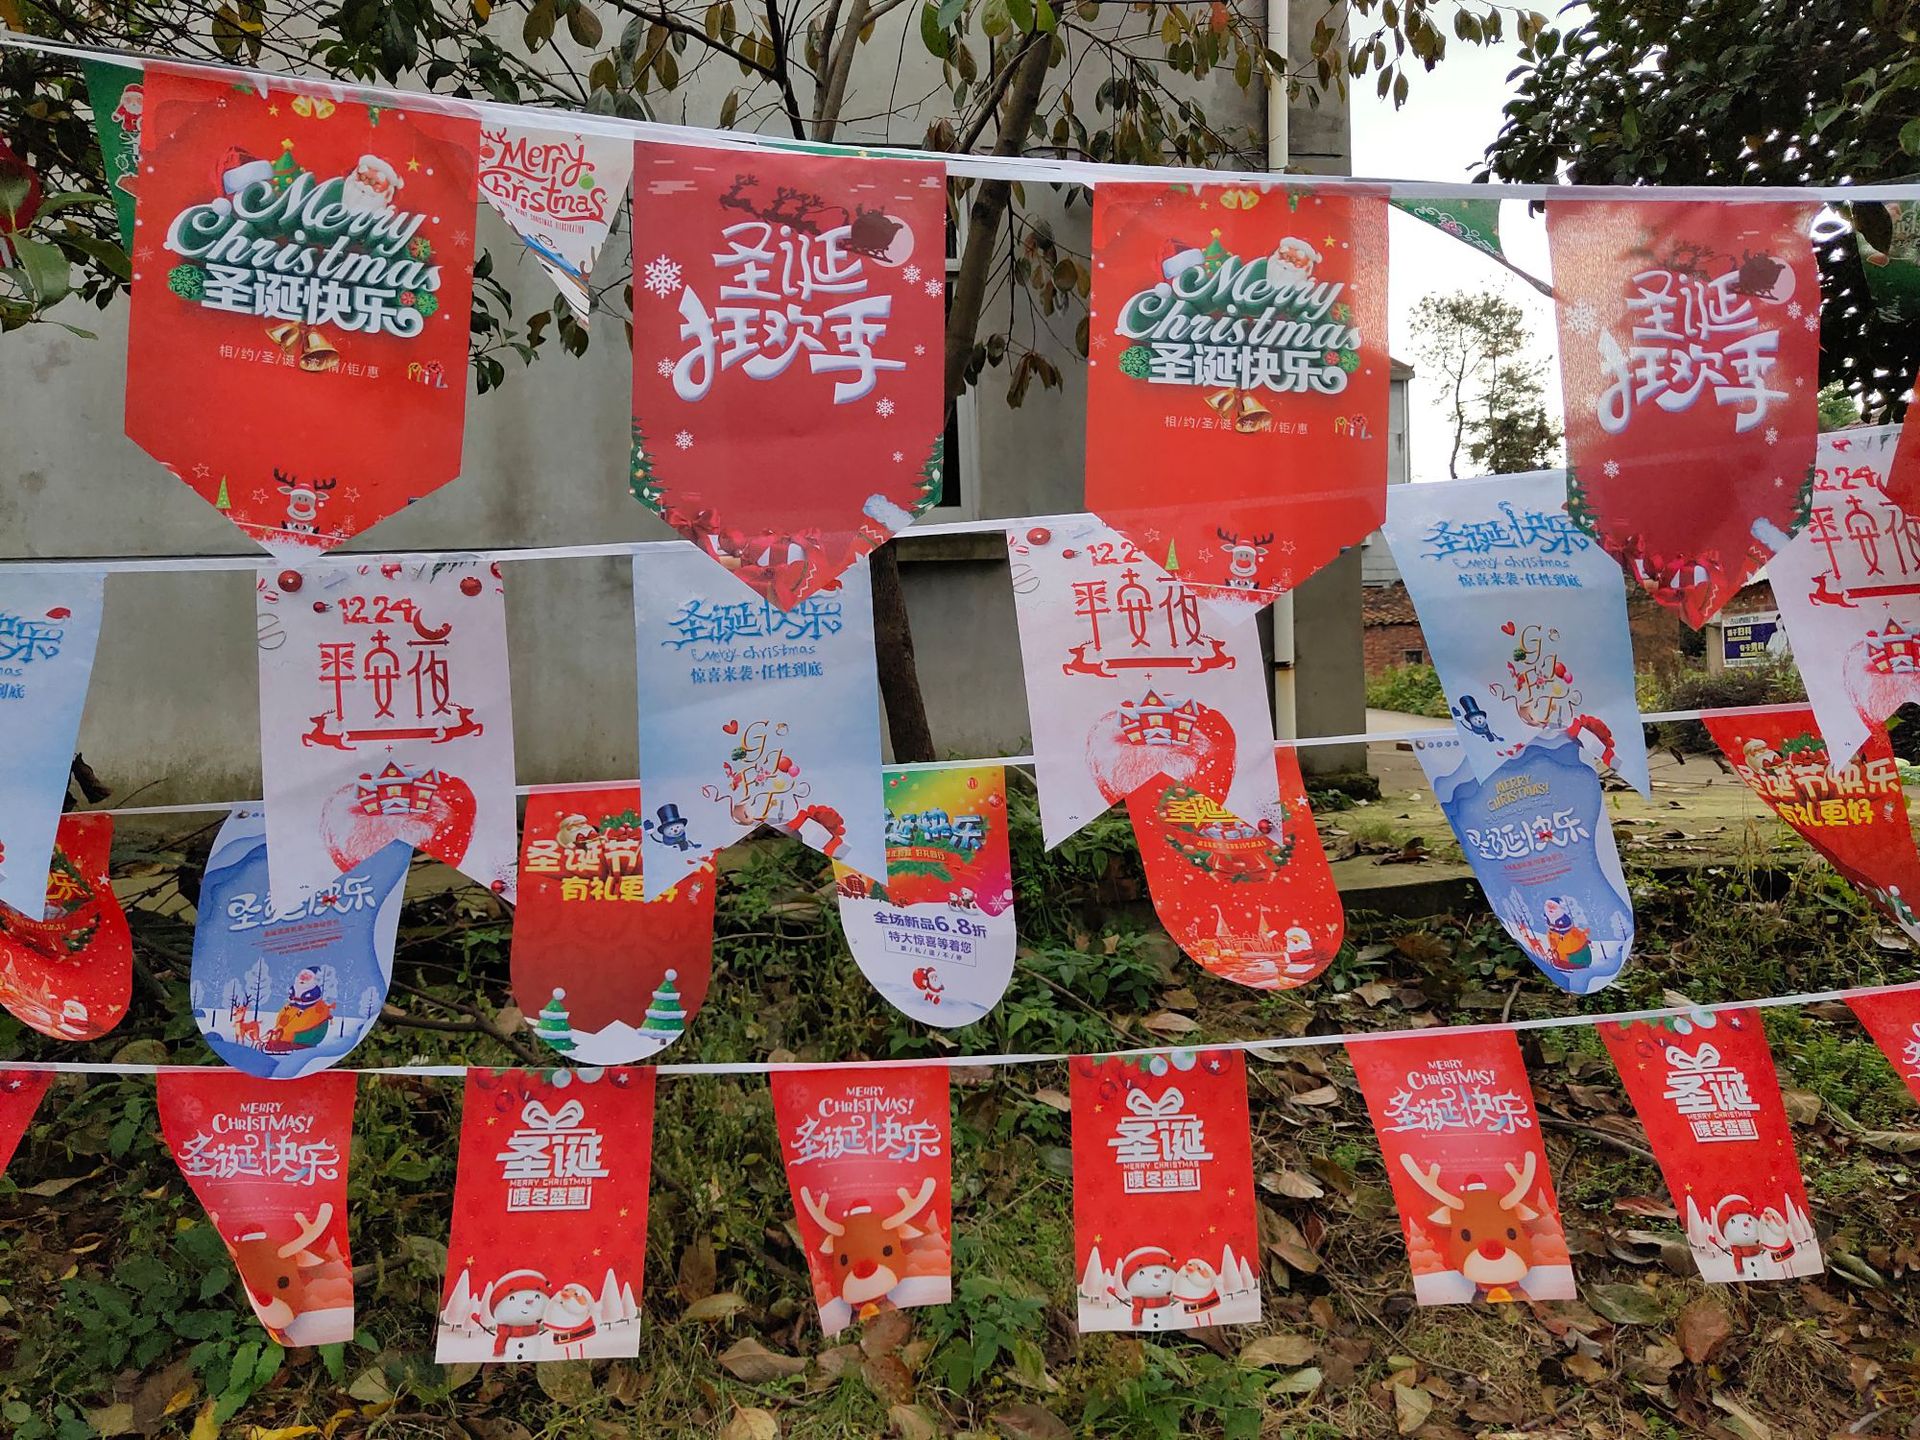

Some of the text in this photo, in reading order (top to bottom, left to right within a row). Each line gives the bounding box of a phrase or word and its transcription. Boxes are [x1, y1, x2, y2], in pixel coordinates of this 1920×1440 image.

[498, 137, 595, 188] Merry
[233, 171, 427, 255] Merry
[479, 169, 608, 226] Christmas
[163, 203, 443, 292] Christmas
[714, 221, 868, 303] 圣诞
[201, 262, 424, 339] 圣诞快乐
[1171, 254, 1344, 320] Merry
[1626, 269, 1759, 341] 圣诞
[1114, 284, 1362, 350] Christmas
[673, 284, 906, 404] 狂欢季
[1148, 342, 1348, 395] 圣诞快乐
[1596, 326, 1790, 434] 狂欢季
[1420, 502, 1590, 562] 圣诞快乐
[661, 596, 843, 651] 圣诞快乐
[1071, 567, 1205, 652] 平安夜
[318, 629, 452, 723] 平安夜
[690, 661, 824, 685] 惊喜来袭·任性到底
[1495, 774, 1533, 795] MERRY
[1466, 807, 1591, 861] 圣诞快乐
[1776, 798, 1876, 828] 有礼更好
[561, 875, 678, 903] 有礼更
[873, 911, 987, 939] 全场新品6.8折
[888, 931, 972, 955] 特大惊喜等着您
[846, 1086, 886, 1097] MERRY
[1427, 1059, 1463, 1071] MERRY
[240, 1102, 285, 1115] MERRY
[1382, 1084, 1532, 1135] 圣诞快乐
[1663, 1072, 1761, 1114] 圣诞
[177, 1129, 341, 1186] 圣诞快乐
[496, 1134, 611, 1180] 圣诞
[788, 1112, 943, 1167] 圣诞快乐
[1107, 1119, 1215, 1164] 圣诞
[1123, 1160, 1199, 1170] MERRY CHRISTMAS
[510, 1177, 592, 1187] MERRY CHRISTMAS
